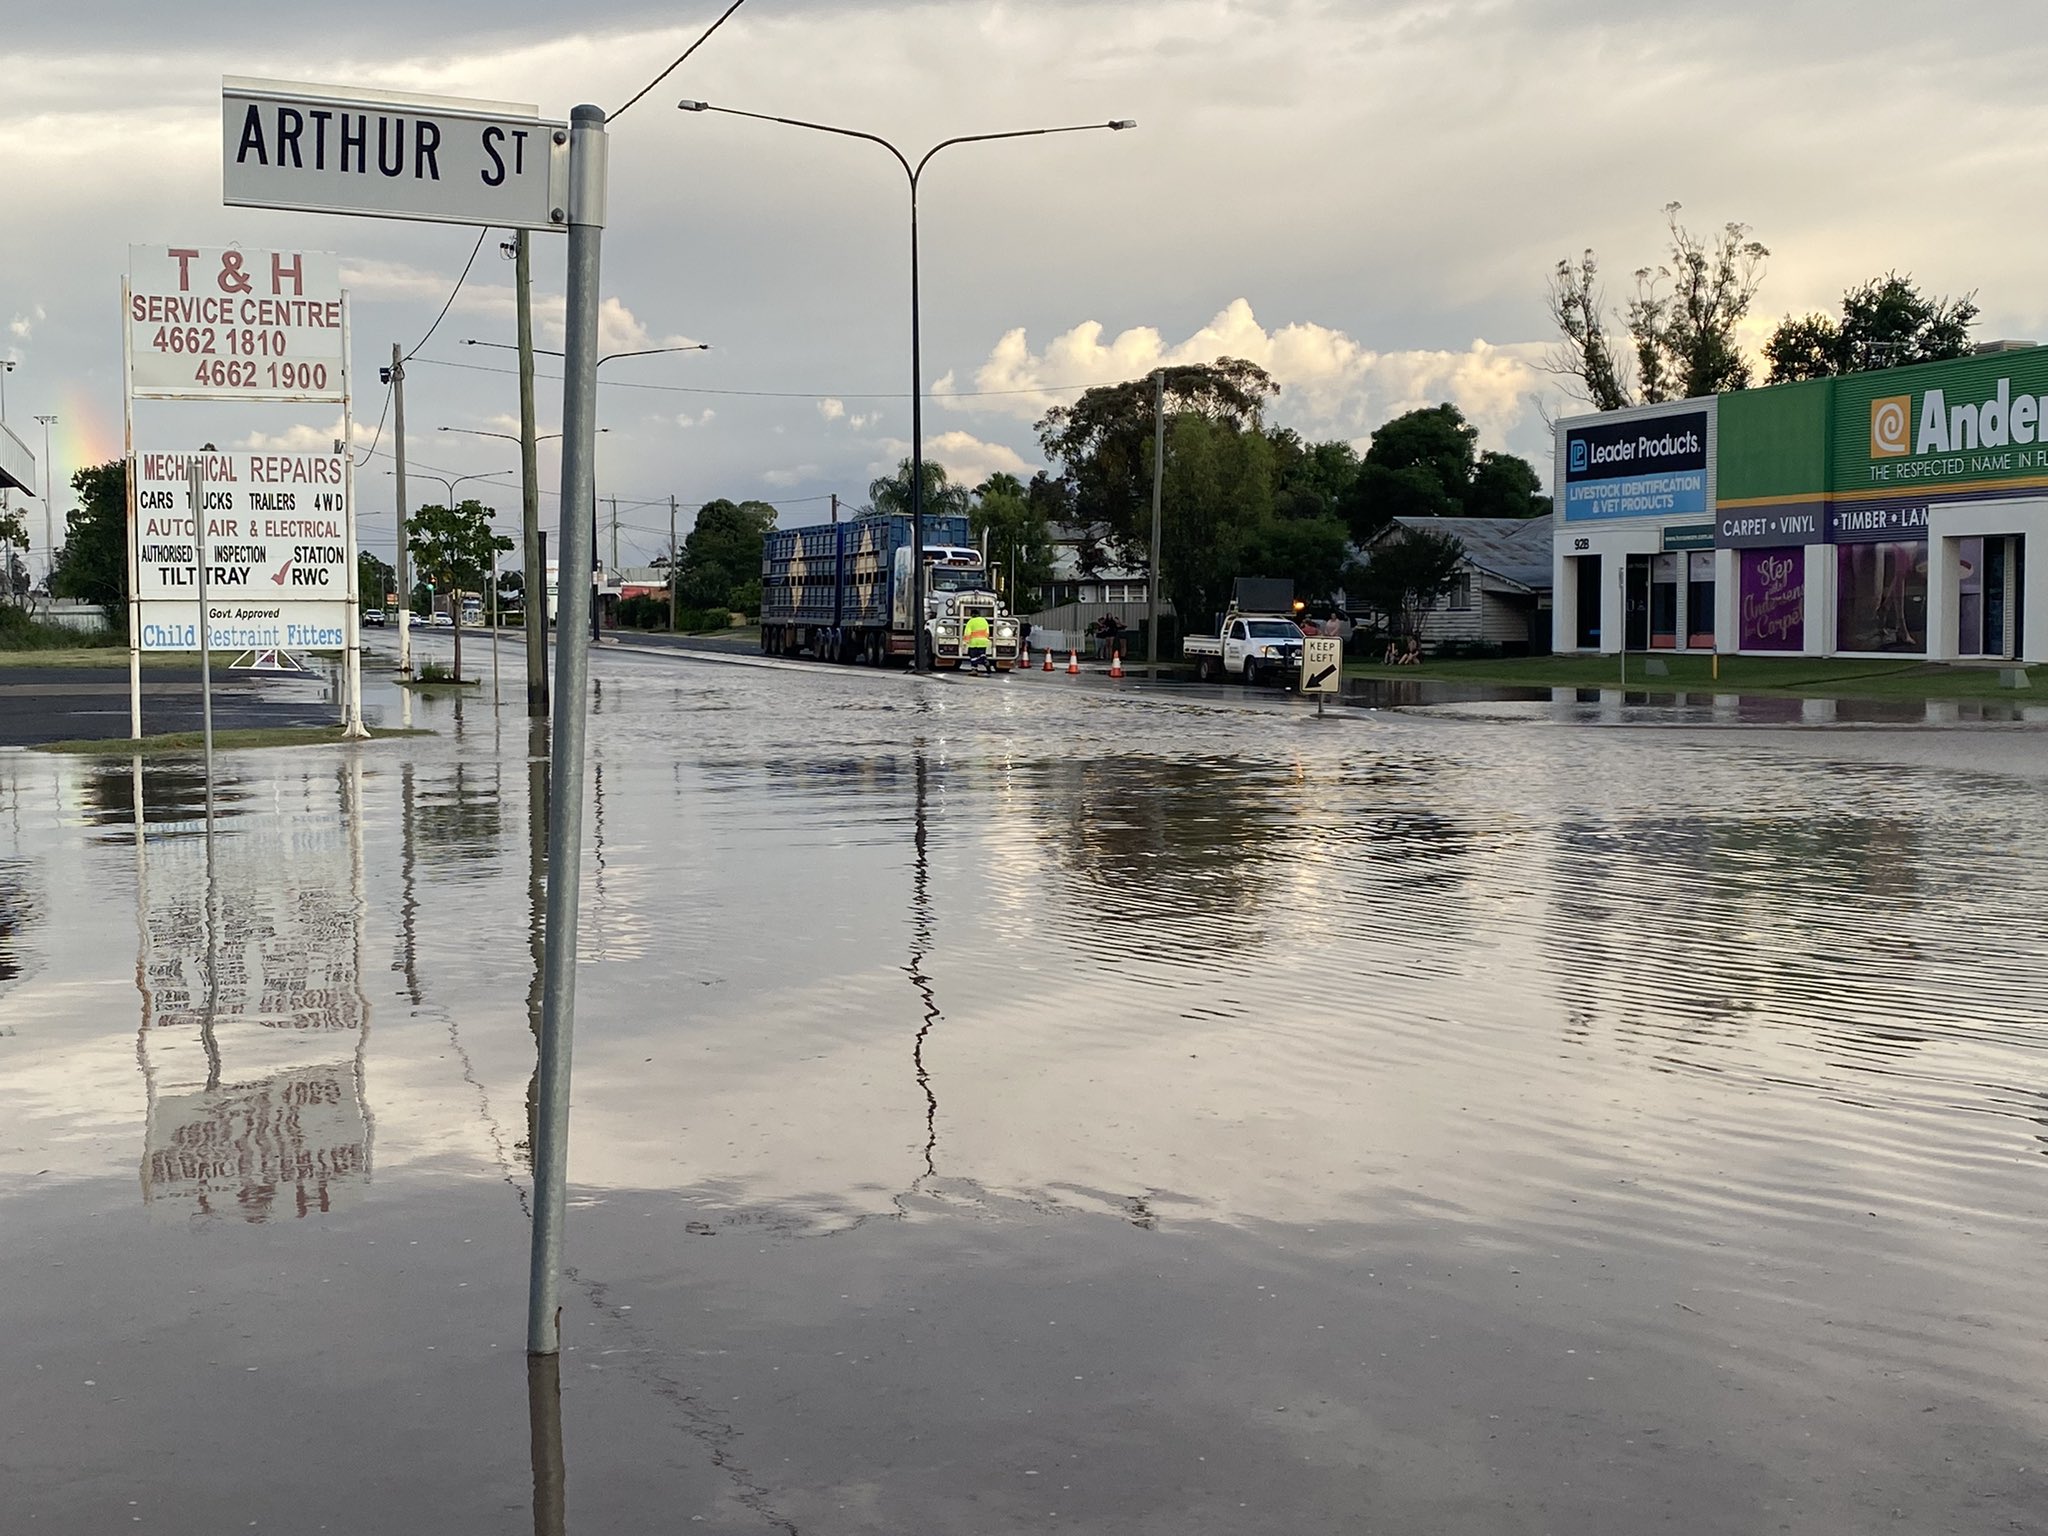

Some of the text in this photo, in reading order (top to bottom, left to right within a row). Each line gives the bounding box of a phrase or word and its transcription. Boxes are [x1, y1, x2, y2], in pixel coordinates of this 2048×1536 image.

[236, 104, 529, 187] ARTHUR ST
[168, 248, 303, 296] T & H
[131, 294, 341, 328] SERVICE CENTRE
[152, 326, 287, 357] 4662 1810
[194, 359, 328, 390] 4662 1900
[1590, 439, 1636, 464] Leader
[250, 456, 342, 485] REPAIRS
[1870, 464, 1890, 481] THE
[1896, 458, 1965, 478] RESPECTED
[1971, 453, 2012, 472] NAME
[2018, 451, 2032, 468] IN
[1570, 475, 1701, 501] LIVESTOCK IDENTIFICATION
[140, 490, 174, 509] CARS
[249, 492, 296, 511] TRAILERS
[1592, 494, 1675, 514] & VET PRODUCTS
[146, 518, 341, 538] AUTO AIR & ELECTRICAL
[1722, 515, 1815, 537] CARPET VINYL
[1841, 510, 1887, 531] TIMBER
[141, 544, 344, 564] AUTHORISED INSPECTION STATION
[158, 567, 329, 586] TILT TRAY RWC
[1756, 555, 1793, 587] Step
[209, 607, 281, 621] Govt. Approved
[143, 624, 197, 648] Child
[286, 624, 343, 646] Fitters
[1309, 642, 1336, 652] KEEP
[1310, 653, 1335, 663] LEFT
